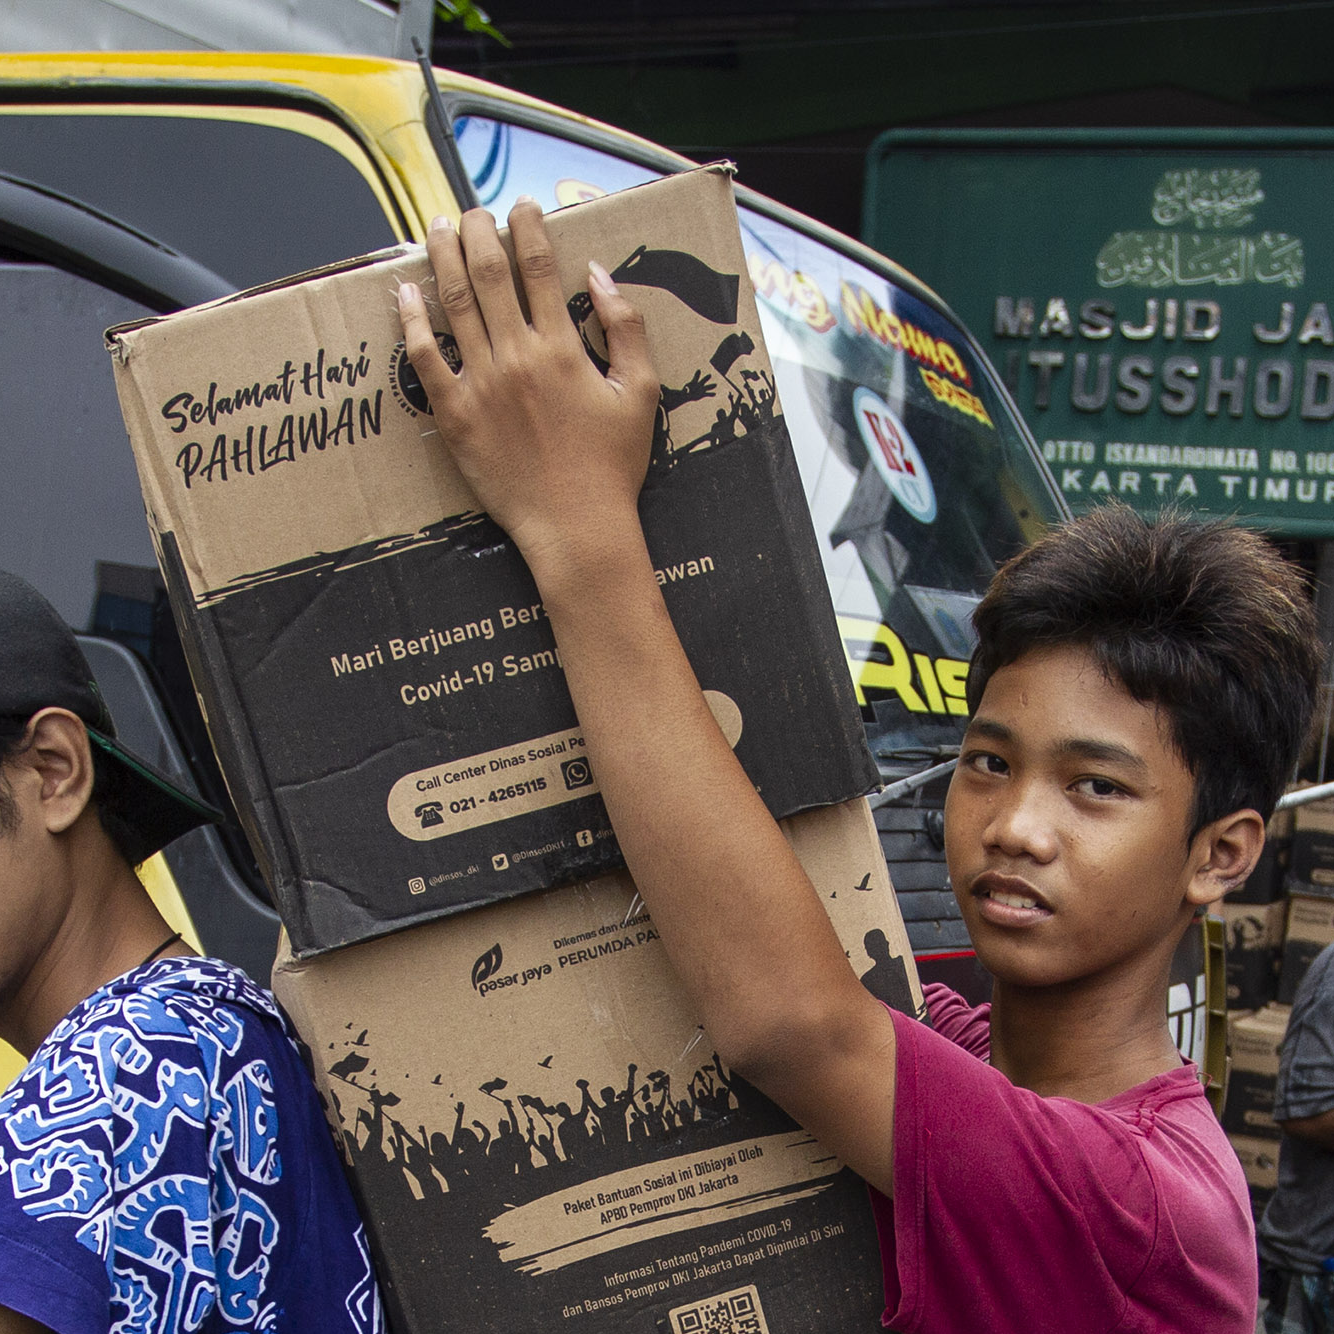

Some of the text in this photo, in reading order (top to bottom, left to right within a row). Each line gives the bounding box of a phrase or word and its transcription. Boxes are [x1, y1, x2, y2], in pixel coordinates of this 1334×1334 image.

[994, 297, 1222, 342] MASJID
[161, 361, 297, 433] Selamat
[300, 341, 370, 399] Hari
[175, 389, 383, 489] PAHLAWAN
[1043, 440, 1095, 464] OTTO
[1062, 468, 1198, 497] KARTA
[330, 644, 384, 677] Mari
[389, 616, 496, 662] Berjuang
[655, 555, 715, 586] awan
[399, 647, 563, 706] Covid-19 Sam
[416, 775, 442, 793] Call
[443, 763, 487, 786] Center
[489, 752, 526, 773] Dinas
[528, 742, 567, 762] Sosial
[449, 796, 478, 815] 021
[487, 776, 547, 803] 4265115
[553, 930, 597, 950] Dikemas
[598, 922, 618, 936] dan
[558, 936, 635, 968] PERUMDA
[563, 1145, 764, 1215] Paket Bantuan Sosial ini Dibiayai Oleh
[600, 1173, 739, 1225] APBD Pemprov DKI Jakarta
[562, 1222, 845, 1319] dan Bansos Pemprov DKI Jakarta Dapat Dipindai Di Sini
[604, 1218, 792, 1288] Informasi Tentang Pandemi COVID-19
